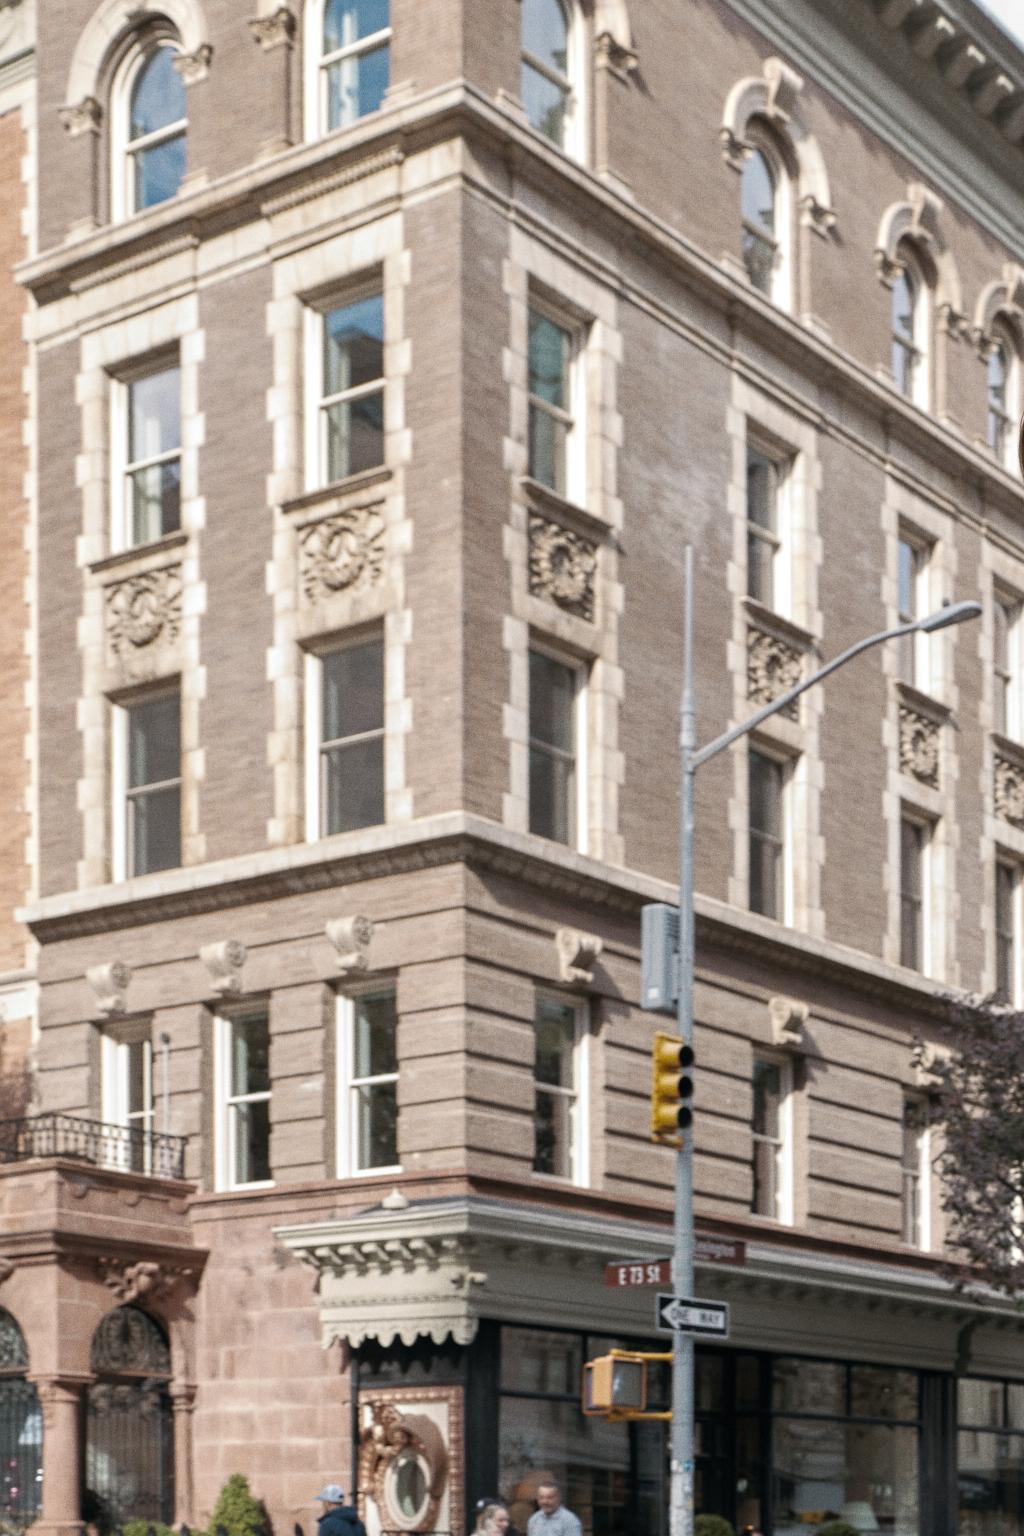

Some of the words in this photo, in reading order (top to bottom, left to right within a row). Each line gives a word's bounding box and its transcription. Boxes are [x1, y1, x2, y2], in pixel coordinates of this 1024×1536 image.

[619, 1267, 626, 1285] E
[629, 1266, 643, 1284] 73
[647, 1264, 660, 1283] St
[671, 1307, 688, 1321] ONE
[701, 1311, 720, 1324] WAY
